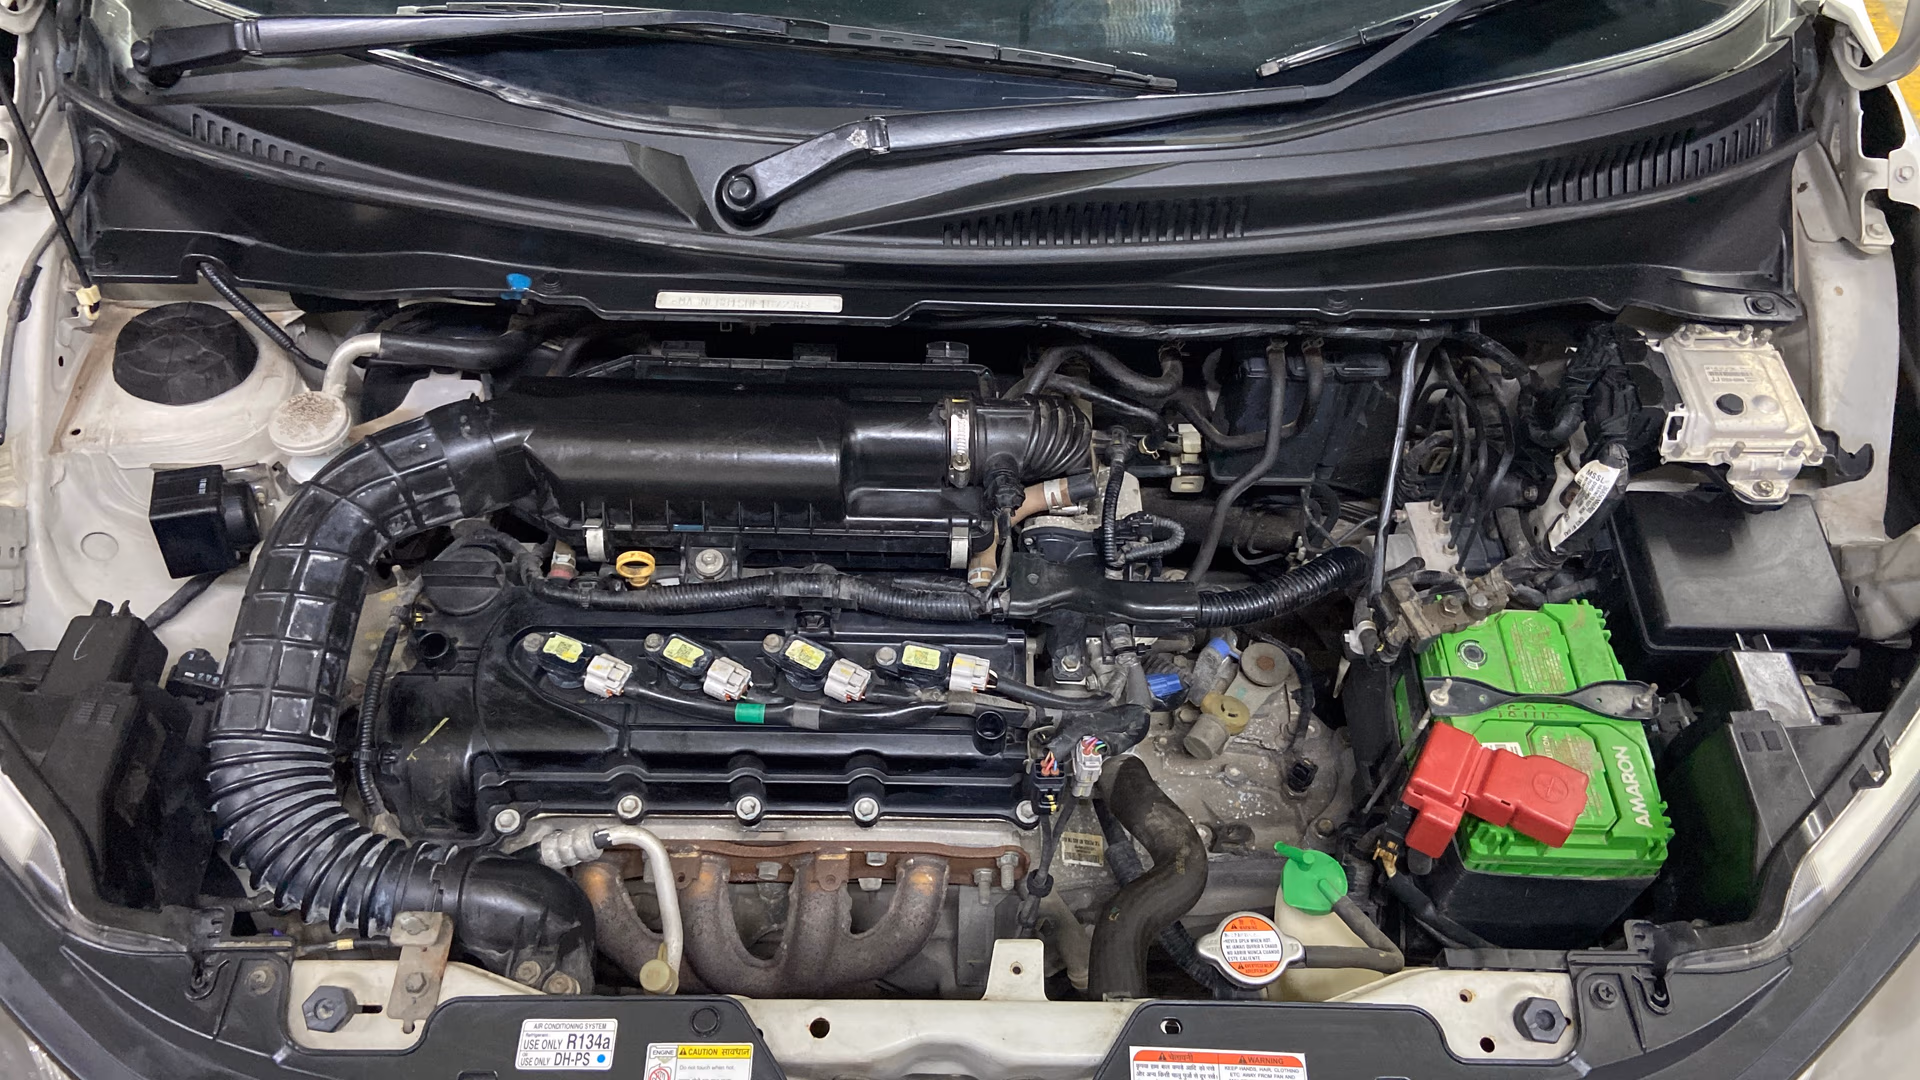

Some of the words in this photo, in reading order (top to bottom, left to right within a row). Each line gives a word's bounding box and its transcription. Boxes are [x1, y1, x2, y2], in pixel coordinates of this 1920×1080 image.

[1611, 745, 1654, 828] AMARON
[524, 1040, 540, 1049] USE
[542, 1040, 563, 1049] ONLY
[566, 1033, 611, 1049] R134a
[520, 1058, 533, 1066] USE
[534, 1057, 551, 1066] ONLY
[554, 1052, 590, 1066] DH-PS
